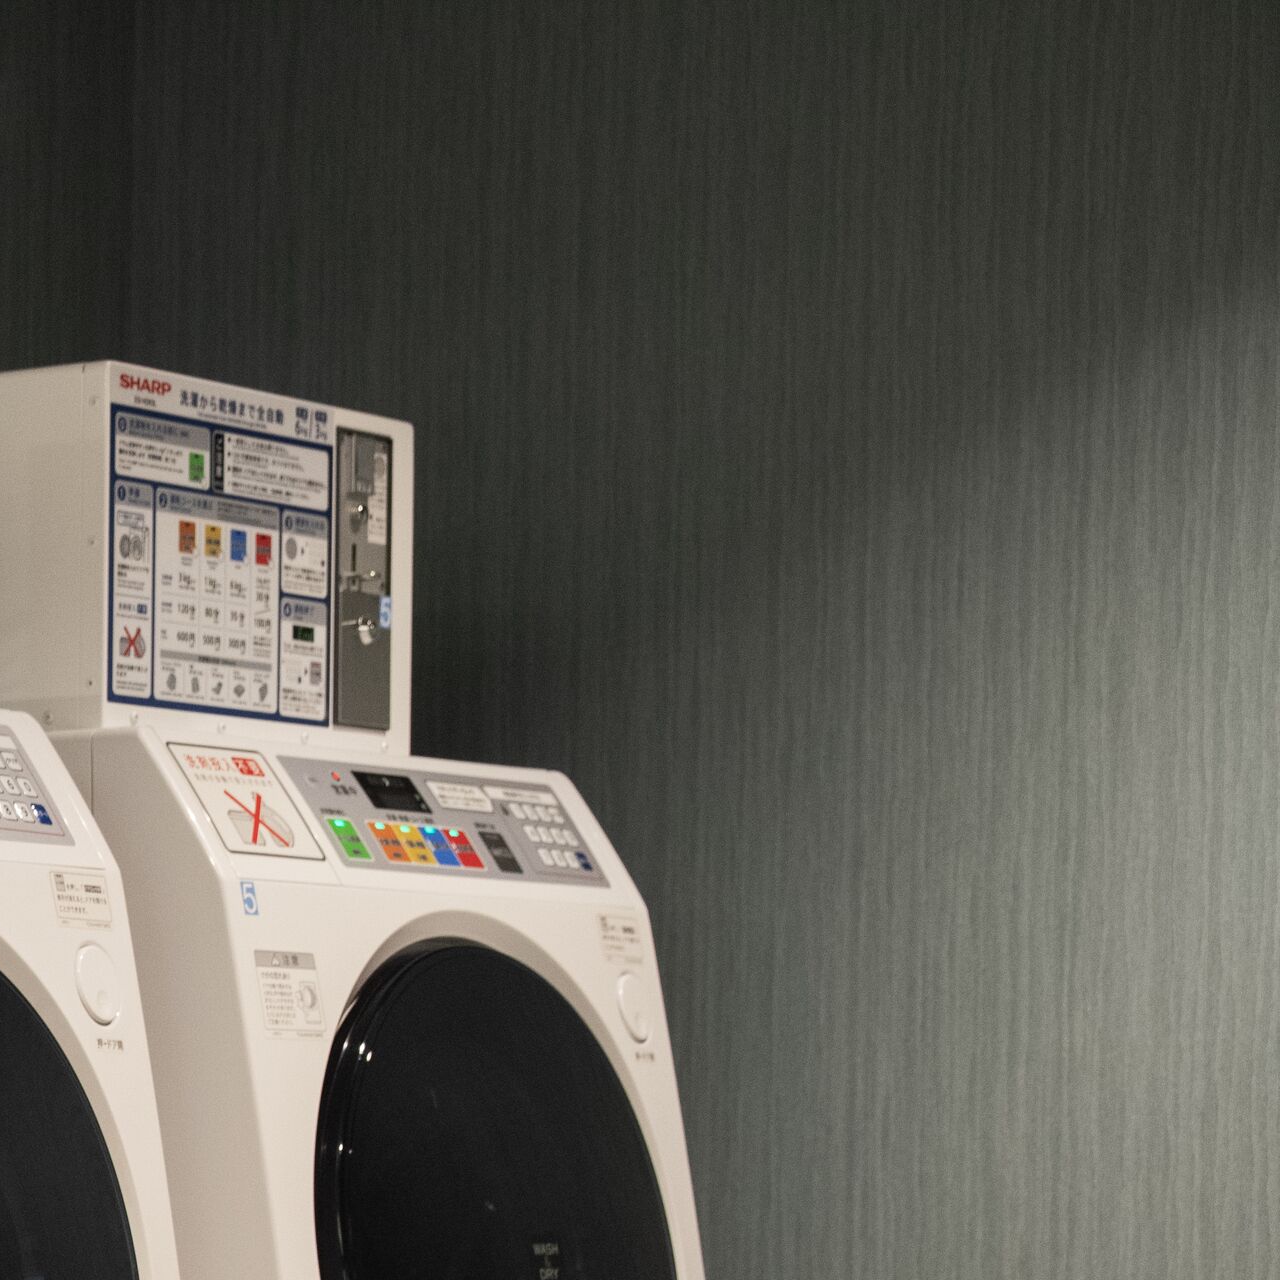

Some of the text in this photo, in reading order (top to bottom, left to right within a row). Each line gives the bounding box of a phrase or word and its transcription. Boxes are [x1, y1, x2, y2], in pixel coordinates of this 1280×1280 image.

[120, 373, 171, 396] SHARP
[380, 597, 391, 627] 5
[243, 884, 257, 914] 5
